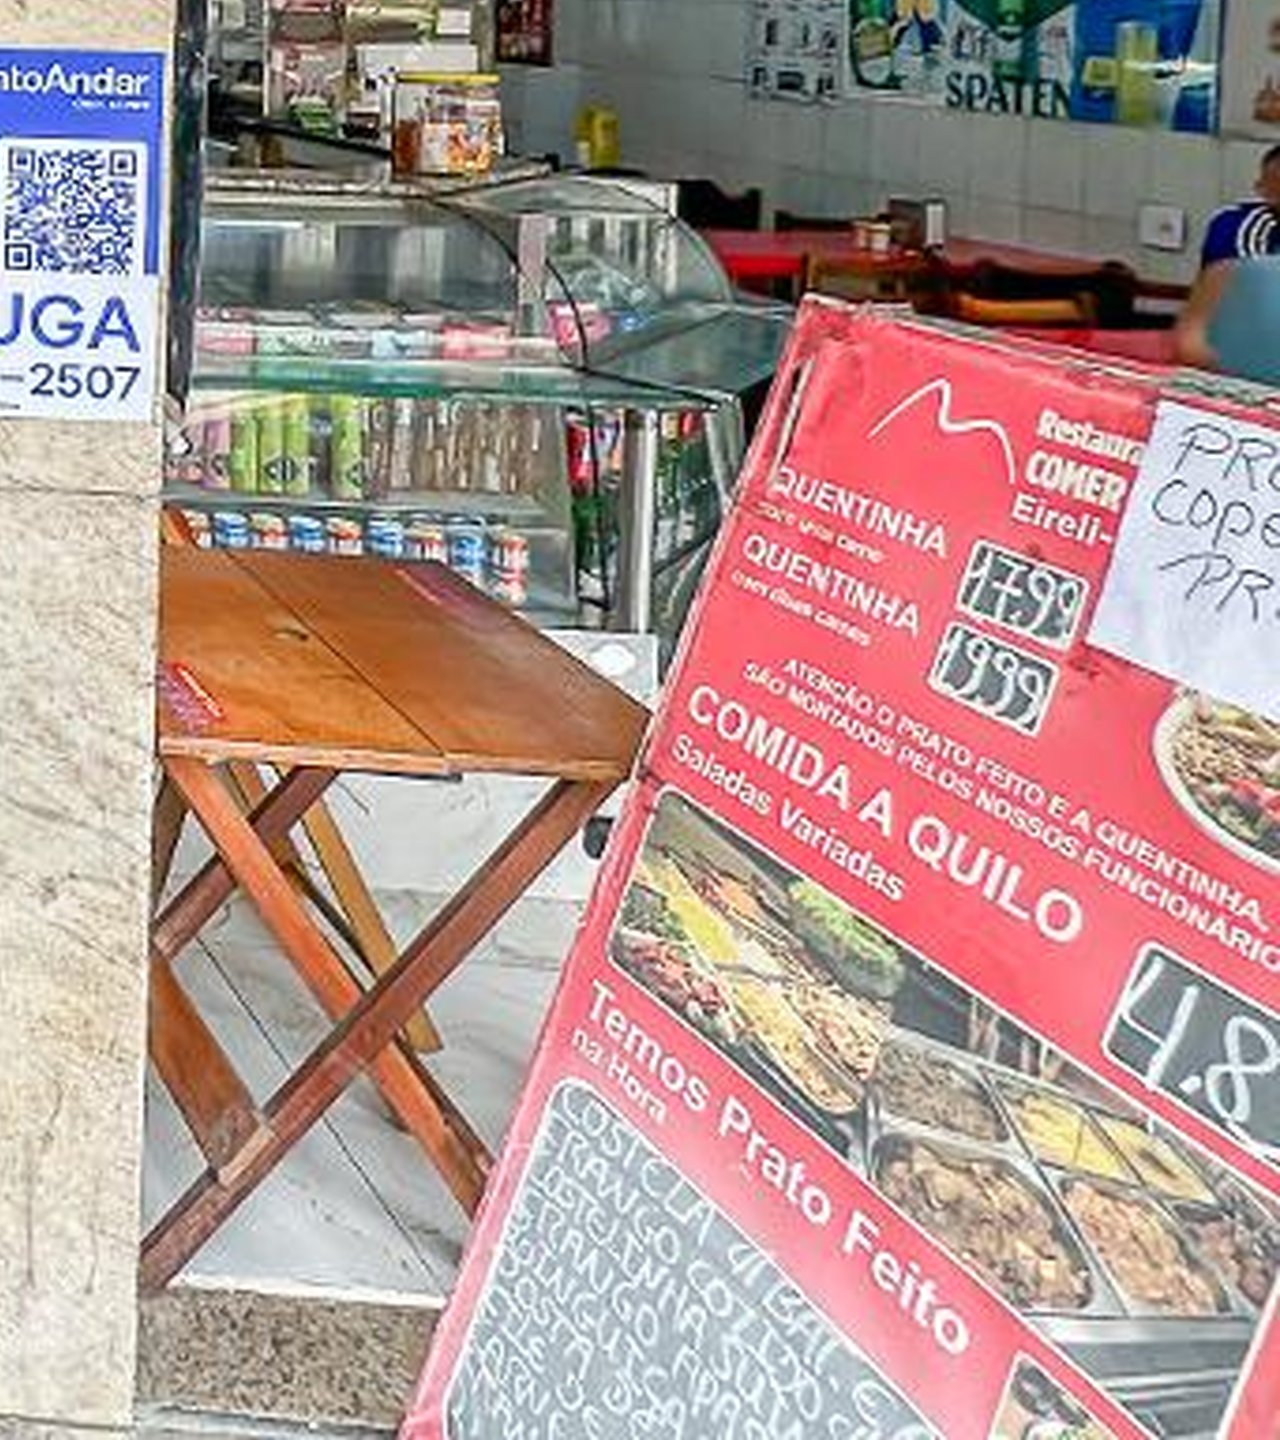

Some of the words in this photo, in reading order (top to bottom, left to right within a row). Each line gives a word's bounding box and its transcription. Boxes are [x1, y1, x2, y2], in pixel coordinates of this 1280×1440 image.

[945, 70, 1070, 119] SPATEN
[773, 467, 947, 558] QUENTINHA
[743, 534, 919, 636] QUENTINHA
[671, 734, 773, 815] Saladas
[779, 799, 906, 902] Variadas
[689, 685, 849, 810] COMIDA
[858, 788, 892, 838] A
[908, 816, 1082, 942] QUILO
[788, 686, 895, 755] MONTADOS
[897, 746, 973, 800] PELOS
[975, 788, 1083, 862] NOSSOS
[896, 715, 971, 767] PRATO
[976, 755, 1044, 805] FEITO
[1047, 794, 1071, 818] E
[1071, 809, 1090, 834] A
[588, 981, 709, 1112] Temos
[719, 1096, 832, 1224] Prato
[843, 1211, 970, 1354] Feito
